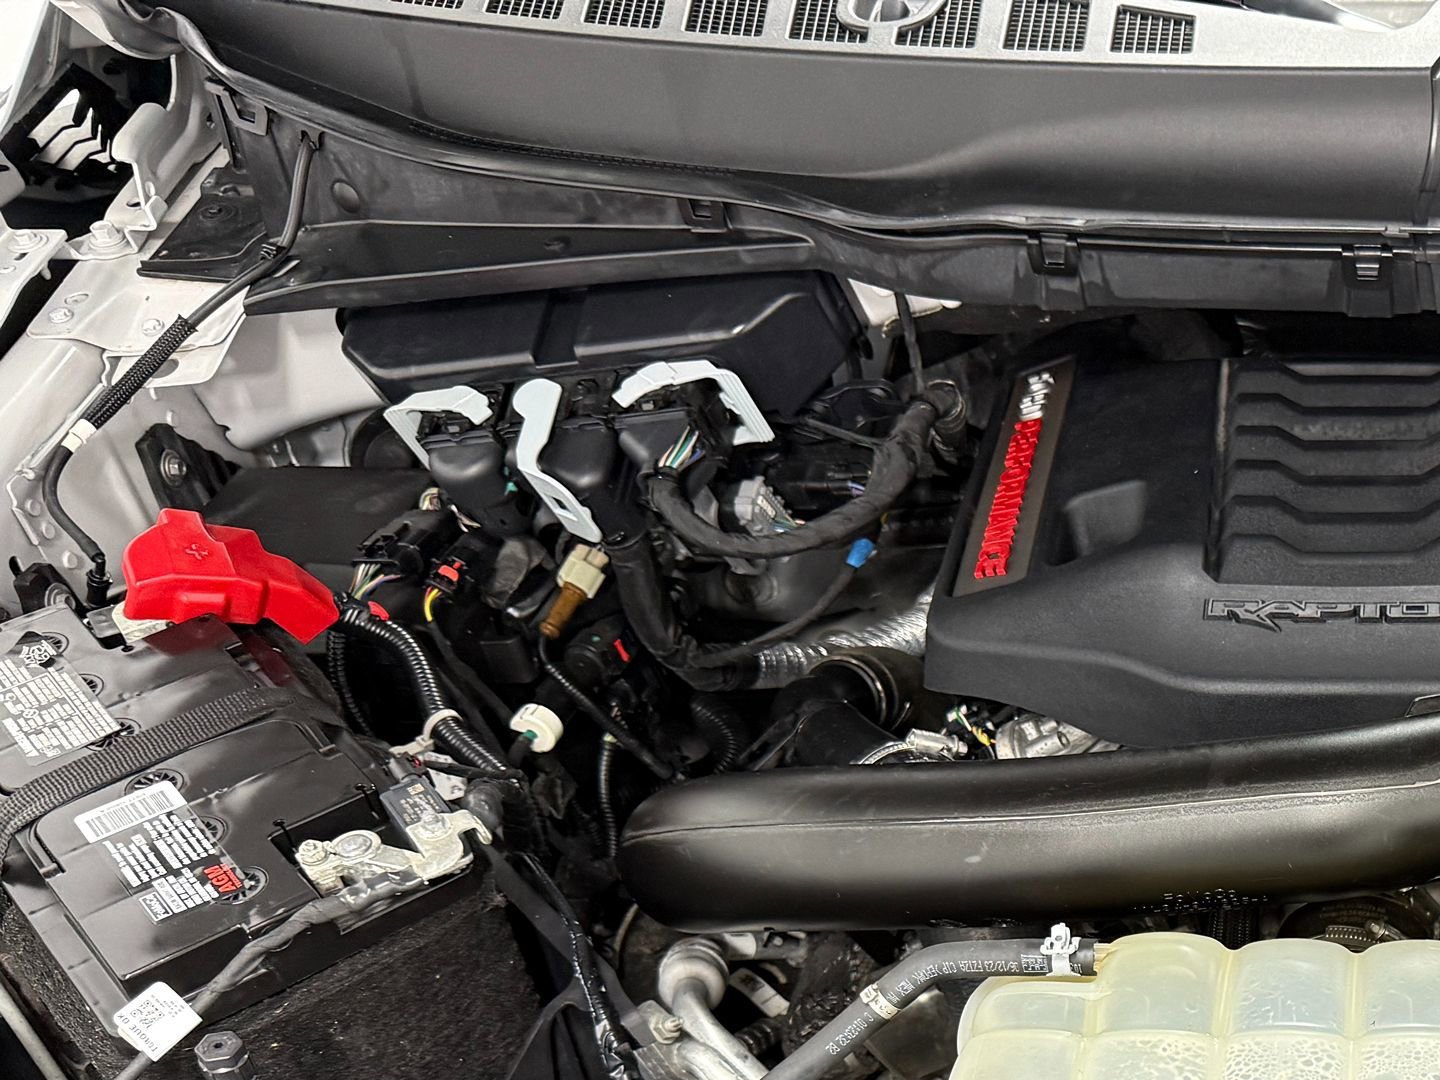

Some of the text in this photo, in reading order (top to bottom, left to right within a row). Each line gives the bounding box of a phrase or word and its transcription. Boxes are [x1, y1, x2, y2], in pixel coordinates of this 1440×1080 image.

[974, 418, 1043, 580] PERFORMANCE
[203, 865, 236, 893] AGM
[128, 1024, 159, 1054] TORQUE
